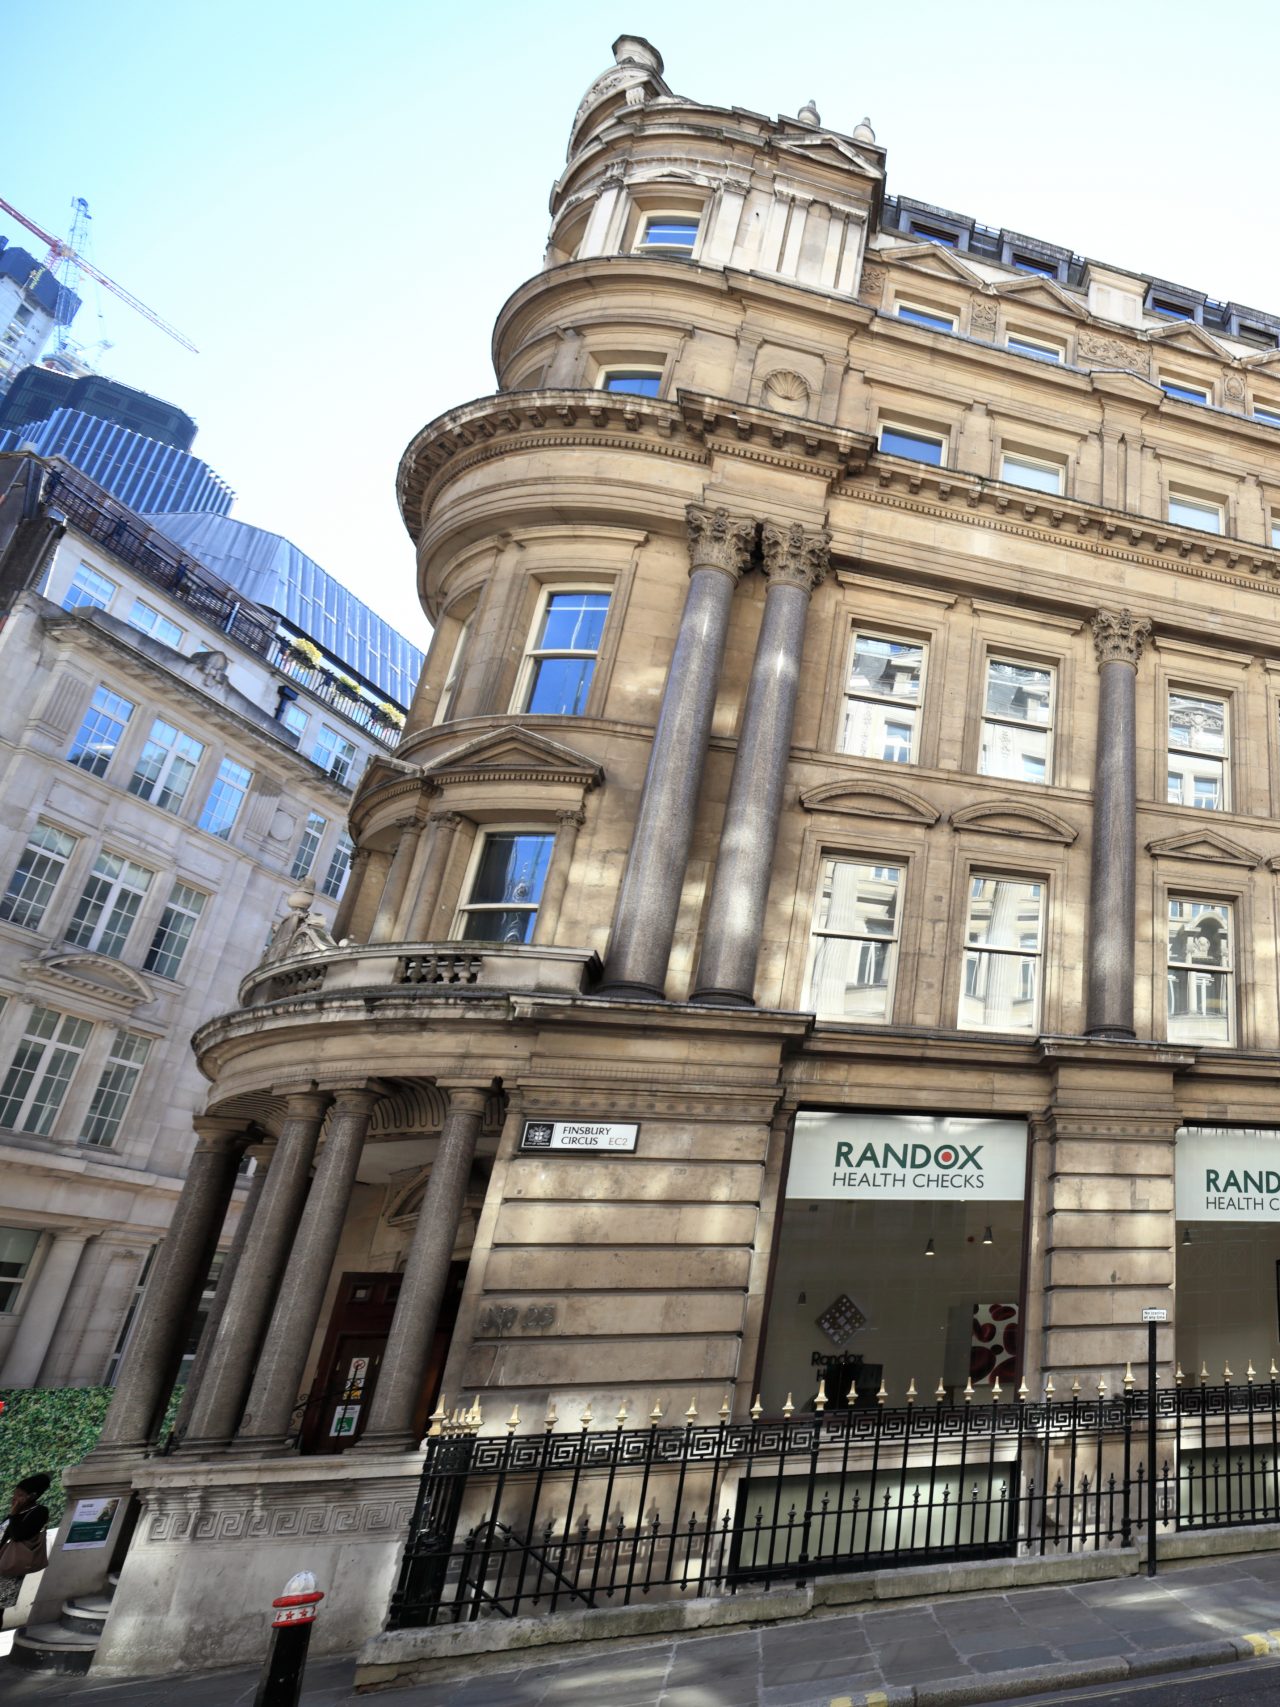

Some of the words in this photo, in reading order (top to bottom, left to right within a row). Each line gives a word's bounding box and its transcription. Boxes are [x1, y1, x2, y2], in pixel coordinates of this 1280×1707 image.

[562, 1126, 612, 1136] FINSBURY
[560, 1136, 599, 1146] CIRCUS
[608, 1137, 628, 1146] EC2
[834, 1141, 985, 1170] RANDOX
[832, 1172, 906, 1188] HEALTH
[912, 1173, 985, 1189] CHECKS
[1205, 1196, 1264, 1211] HEALTH
[811, 1349, 864, 1366] Randox
